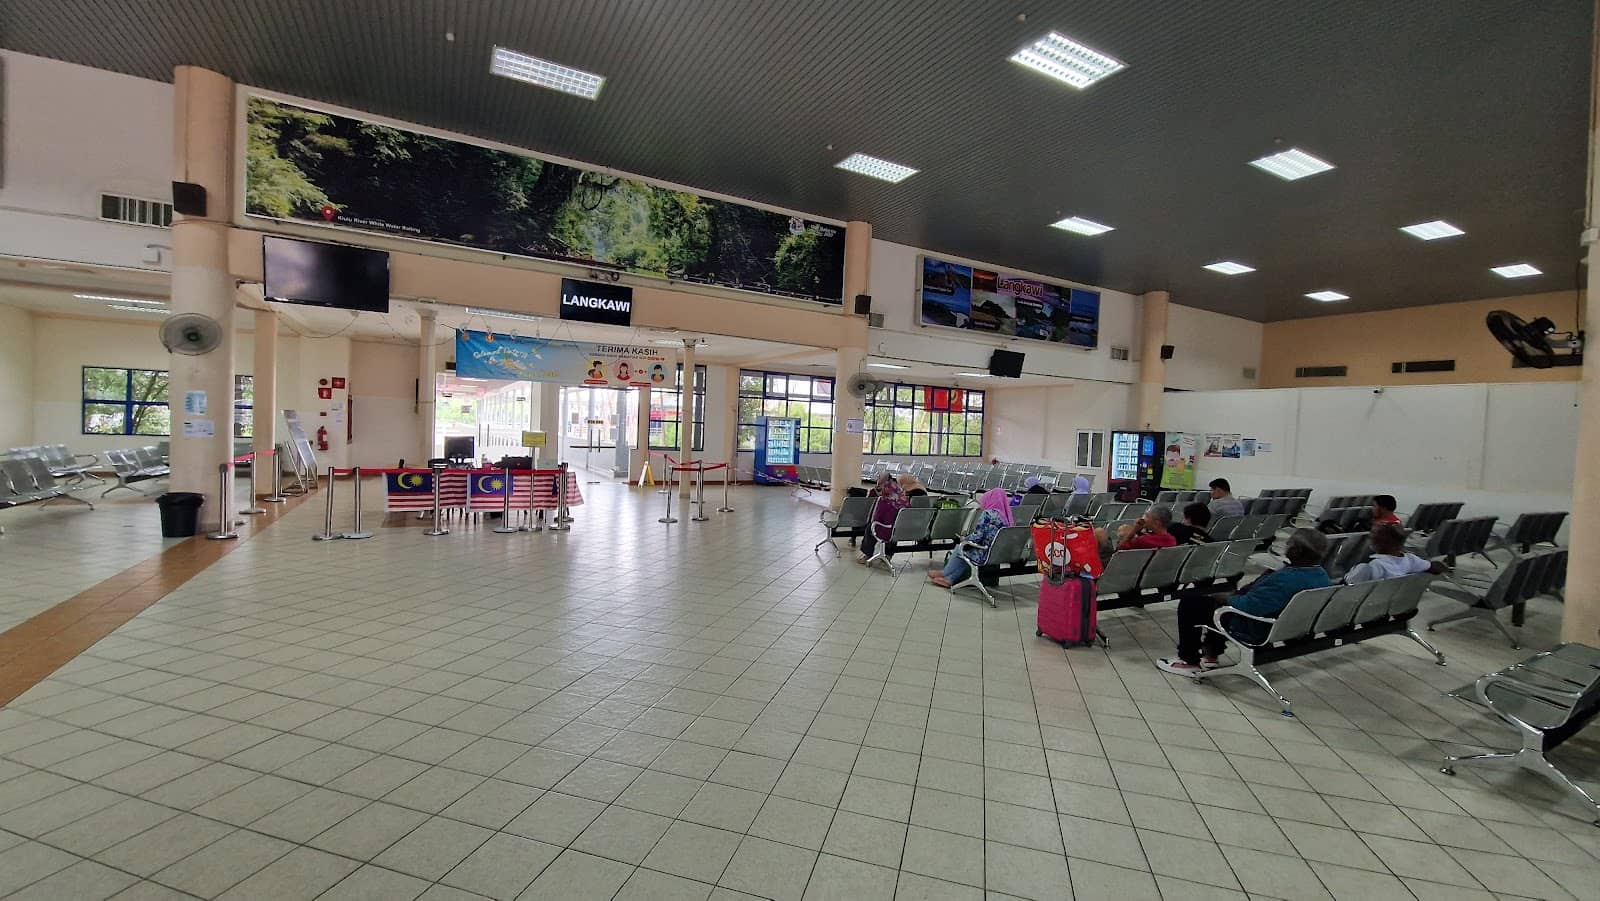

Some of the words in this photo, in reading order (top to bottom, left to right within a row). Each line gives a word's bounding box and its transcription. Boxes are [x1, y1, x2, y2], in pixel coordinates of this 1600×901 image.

[385, 222, 401, 230] Water
[402, 225, 421, 233] Rafting
[998, 276, 1043, 297] Langkawi
[562, 294, 631, 313] LANGKAWI
[597, 345, 630, 354] TERIMA
[631, 347, 658, 357] KASIH
